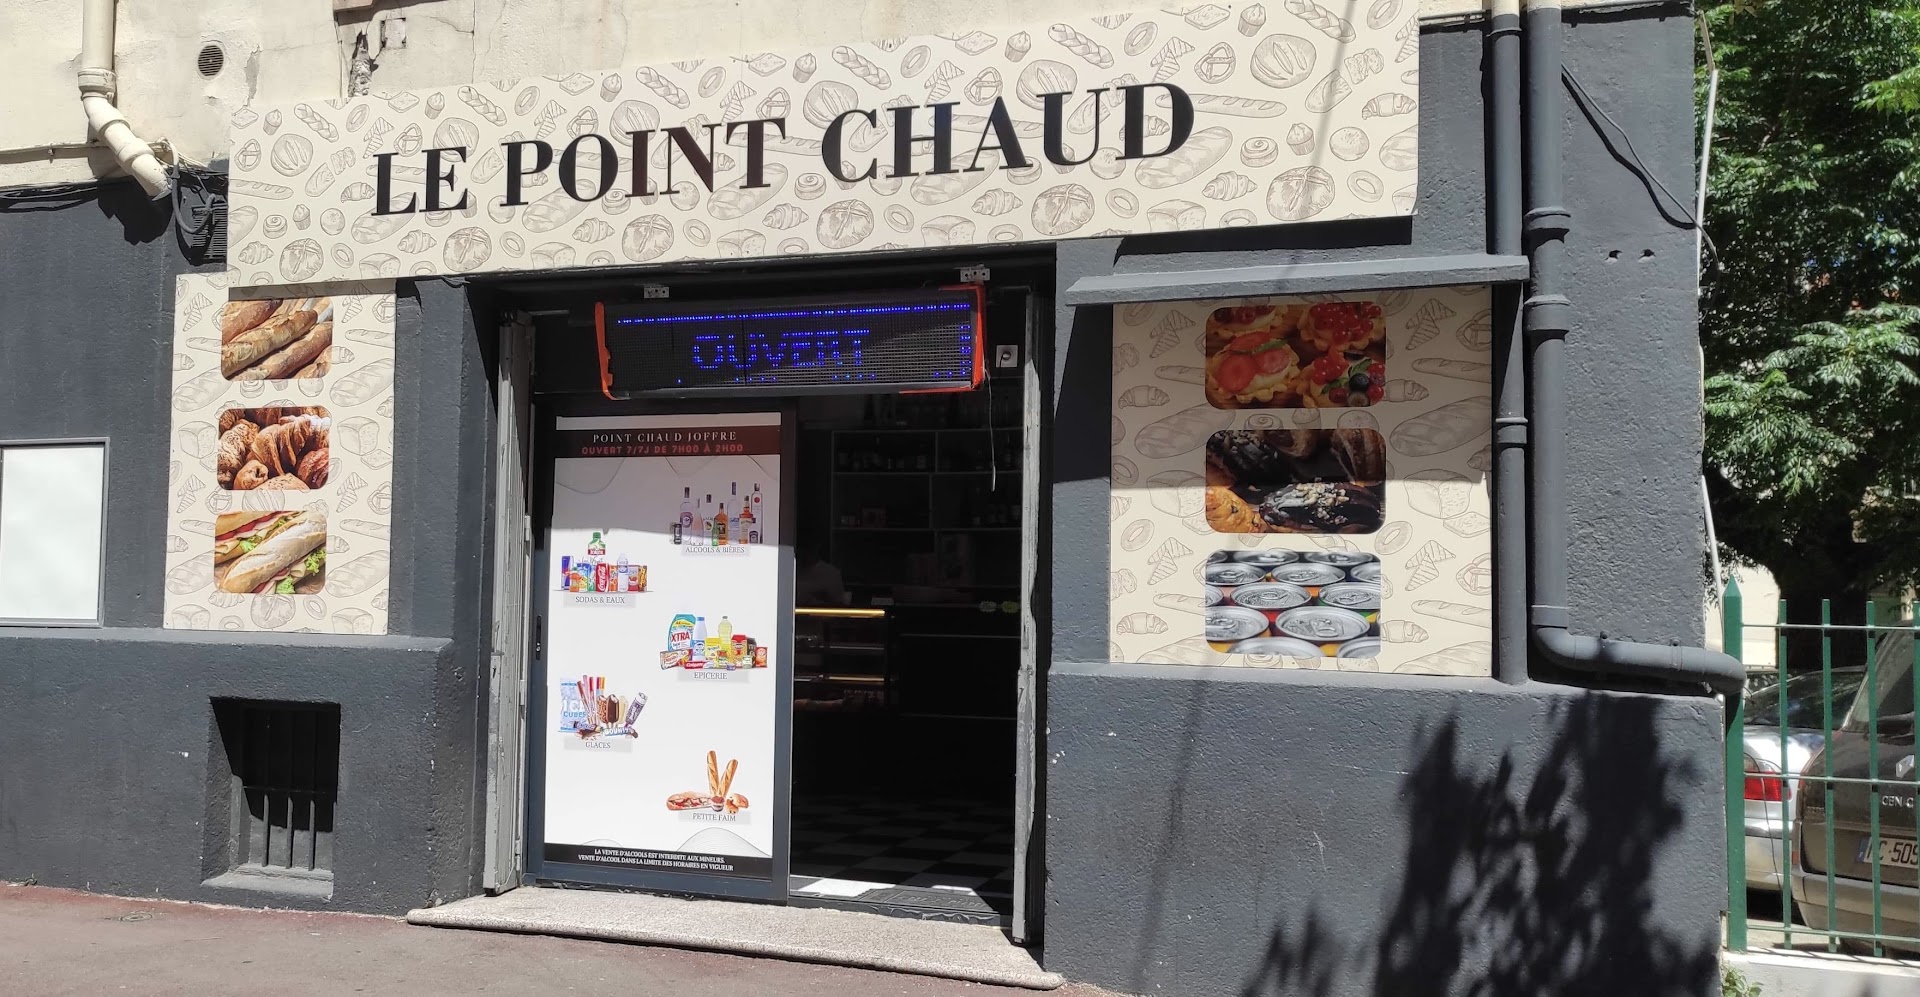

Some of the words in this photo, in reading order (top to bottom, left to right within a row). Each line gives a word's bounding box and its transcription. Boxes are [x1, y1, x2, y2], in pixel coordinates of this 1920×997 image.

[370, 146, 469, 216] LE
[500, 117, 787, 207] POINT
[821, 82, 1195, 183] CHAUD
[692, 329, 870, 369] OUVERT
[593, 433, 632, 443] POINT
[637, 432, 683, 442] CHAUD
[687, 431, 737, 442] JOFFRE
[581, 446, 622, 455] OUVERT
[626, 445, 649, 454] 7/7J
[654, 445, 667, 454] DE
[672, 445, 699, 453] 7H00
[703, 443, 711, 453] À
[715, 443, 744, 453] 2H00
[722, 545, 745, 553] BIÈRES
[575, 596, 599, 604] SODAS
[600, 596, 605, 604] &
[606, 596, 626, 604] EAUX
[671, 631, 691, 642] XTRA
[694, 671, 728, 680] EPICERIE
[585, 741, 611, 749] GLACES
[692, 812, 717, 821] PETITE
[718, 814, 736, 822] FAIM
[620, 850, 648, 858] D'ALCOOLS
[658, 852, 687, 861] INTERDITE
[595, 855, 621, 863] D'ALCOOL
[673, 860, 700, 869] HORAIRES
[709, 863, 734, 871] VIGUEUR
